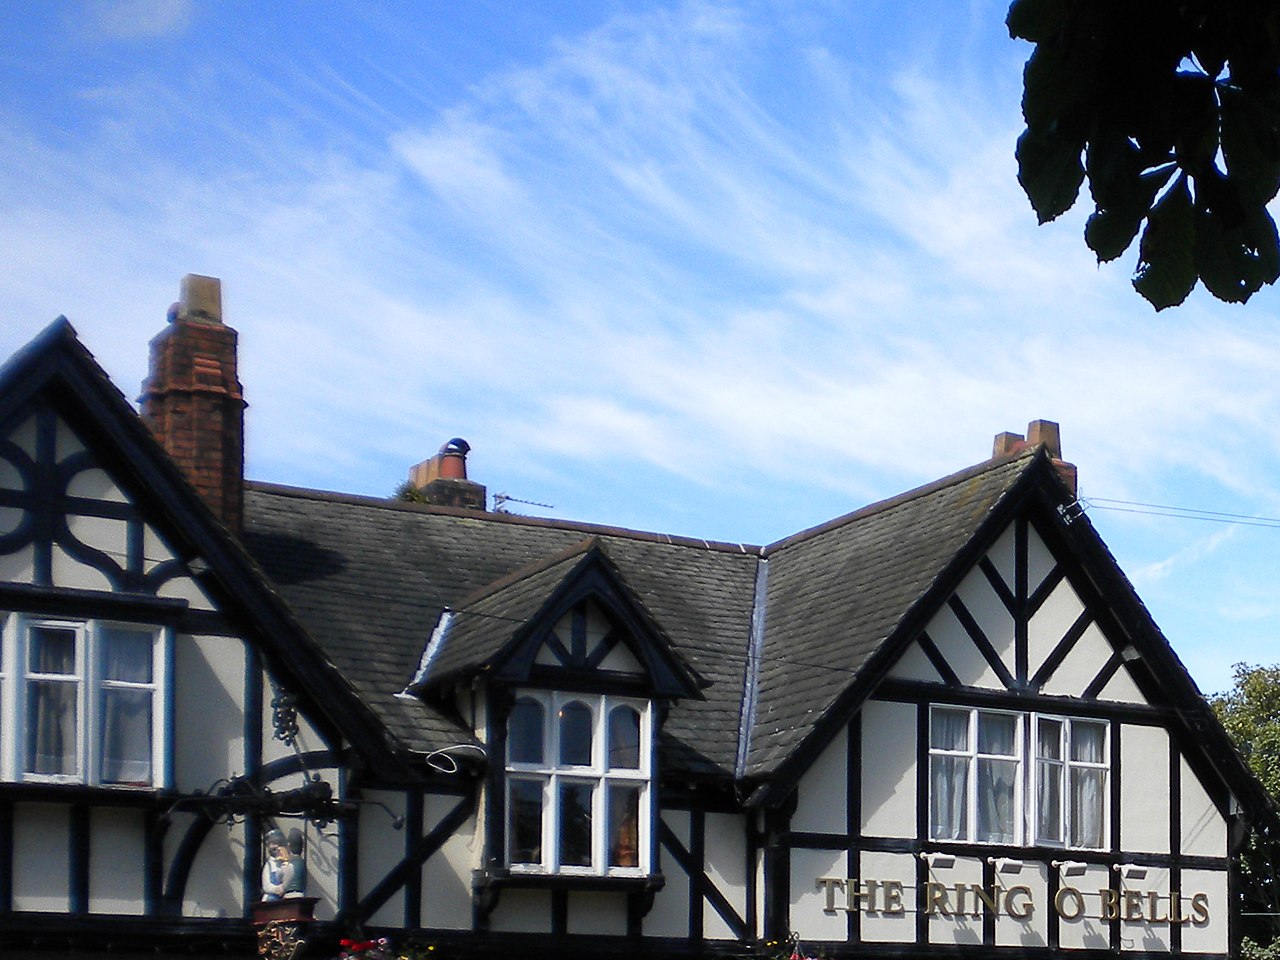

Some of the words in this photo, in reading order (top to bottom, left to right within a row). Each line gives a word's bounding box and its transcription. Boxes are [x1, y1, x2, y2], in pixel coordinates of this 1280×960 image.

[815, 878, 904, 913] THE
[924, 881, 1035, 919] RING
[1054, 886, 1085, 920] O
[1099, 888, 1210, 924] BELLS
